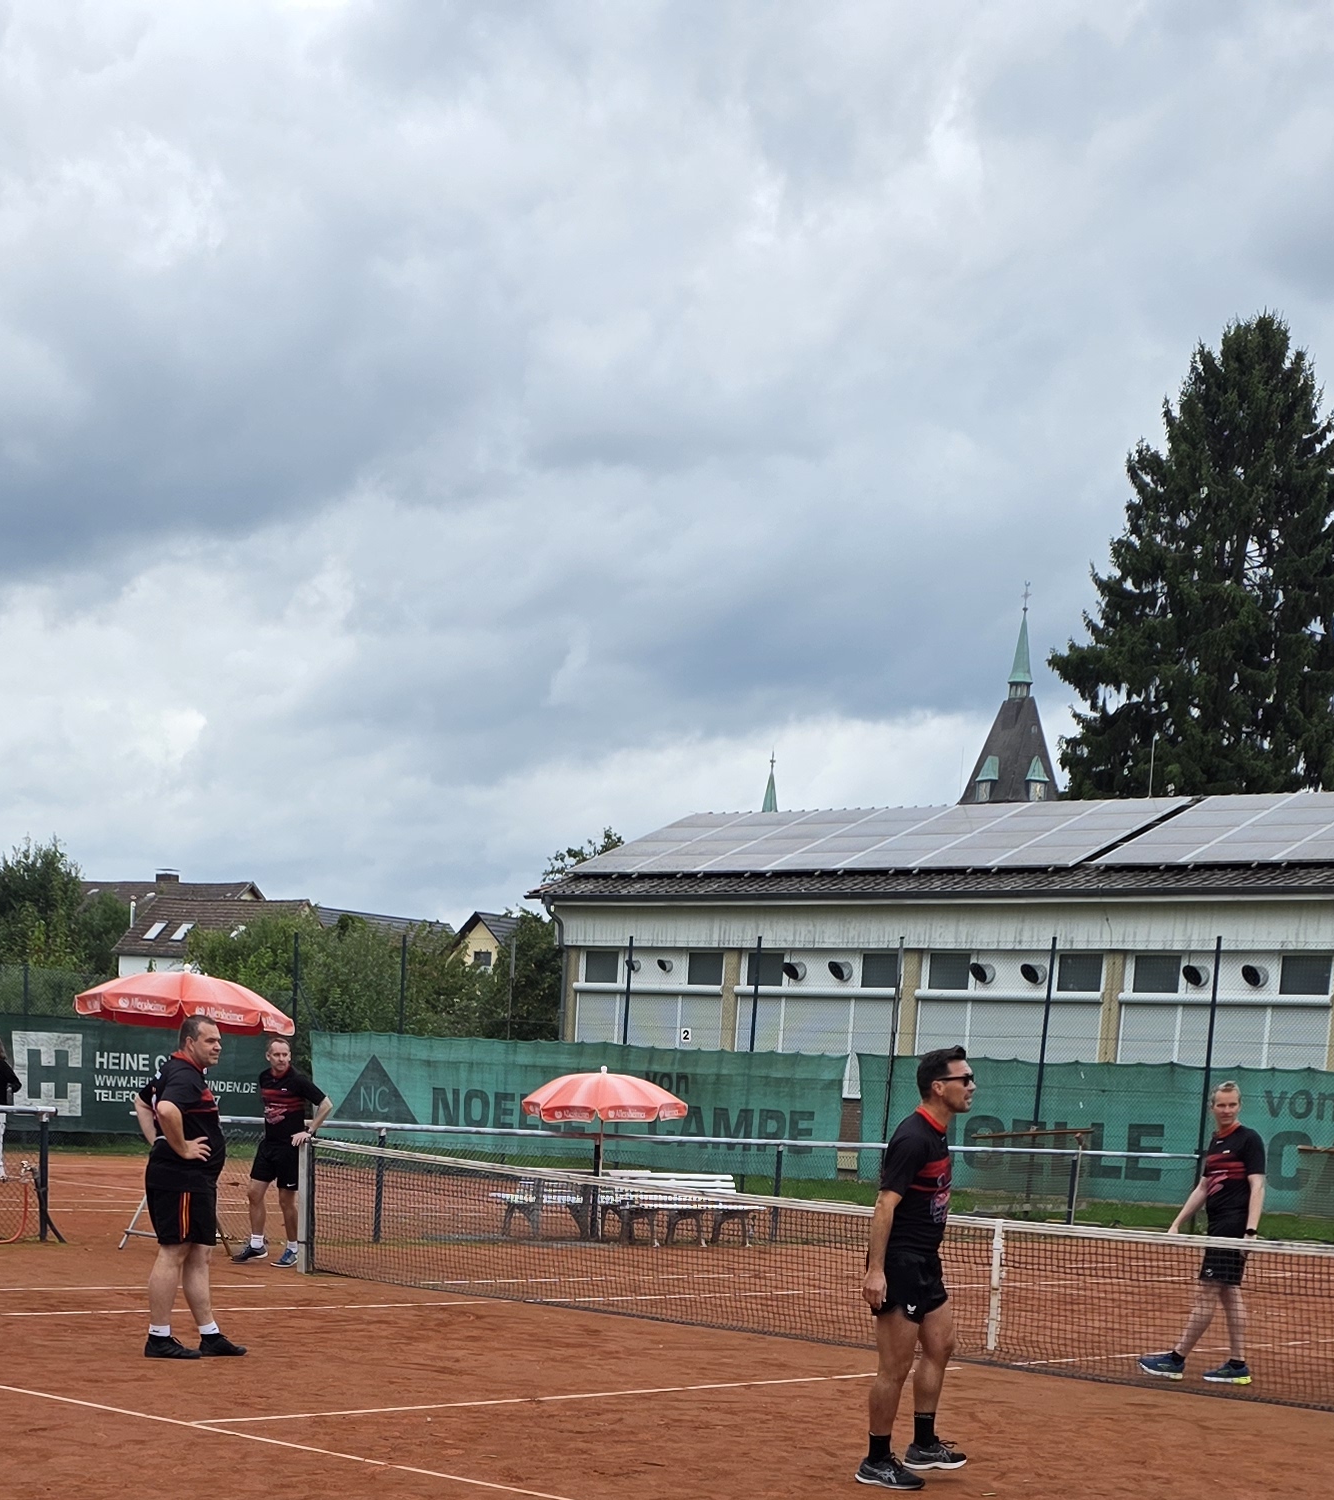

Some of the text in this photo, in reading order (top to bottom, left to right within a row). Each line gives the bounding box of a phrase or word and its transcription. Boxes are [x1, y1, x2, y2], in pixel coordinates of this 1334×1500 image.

[682, 1029, 690, 1040] 2
[95, 1051, 150, 1072] HEINE
[360, 1085, 389, 1113] NC
[432, 1087, 585, 1132] NOEL
[948, 1113, 1165, 1181] OELLE
